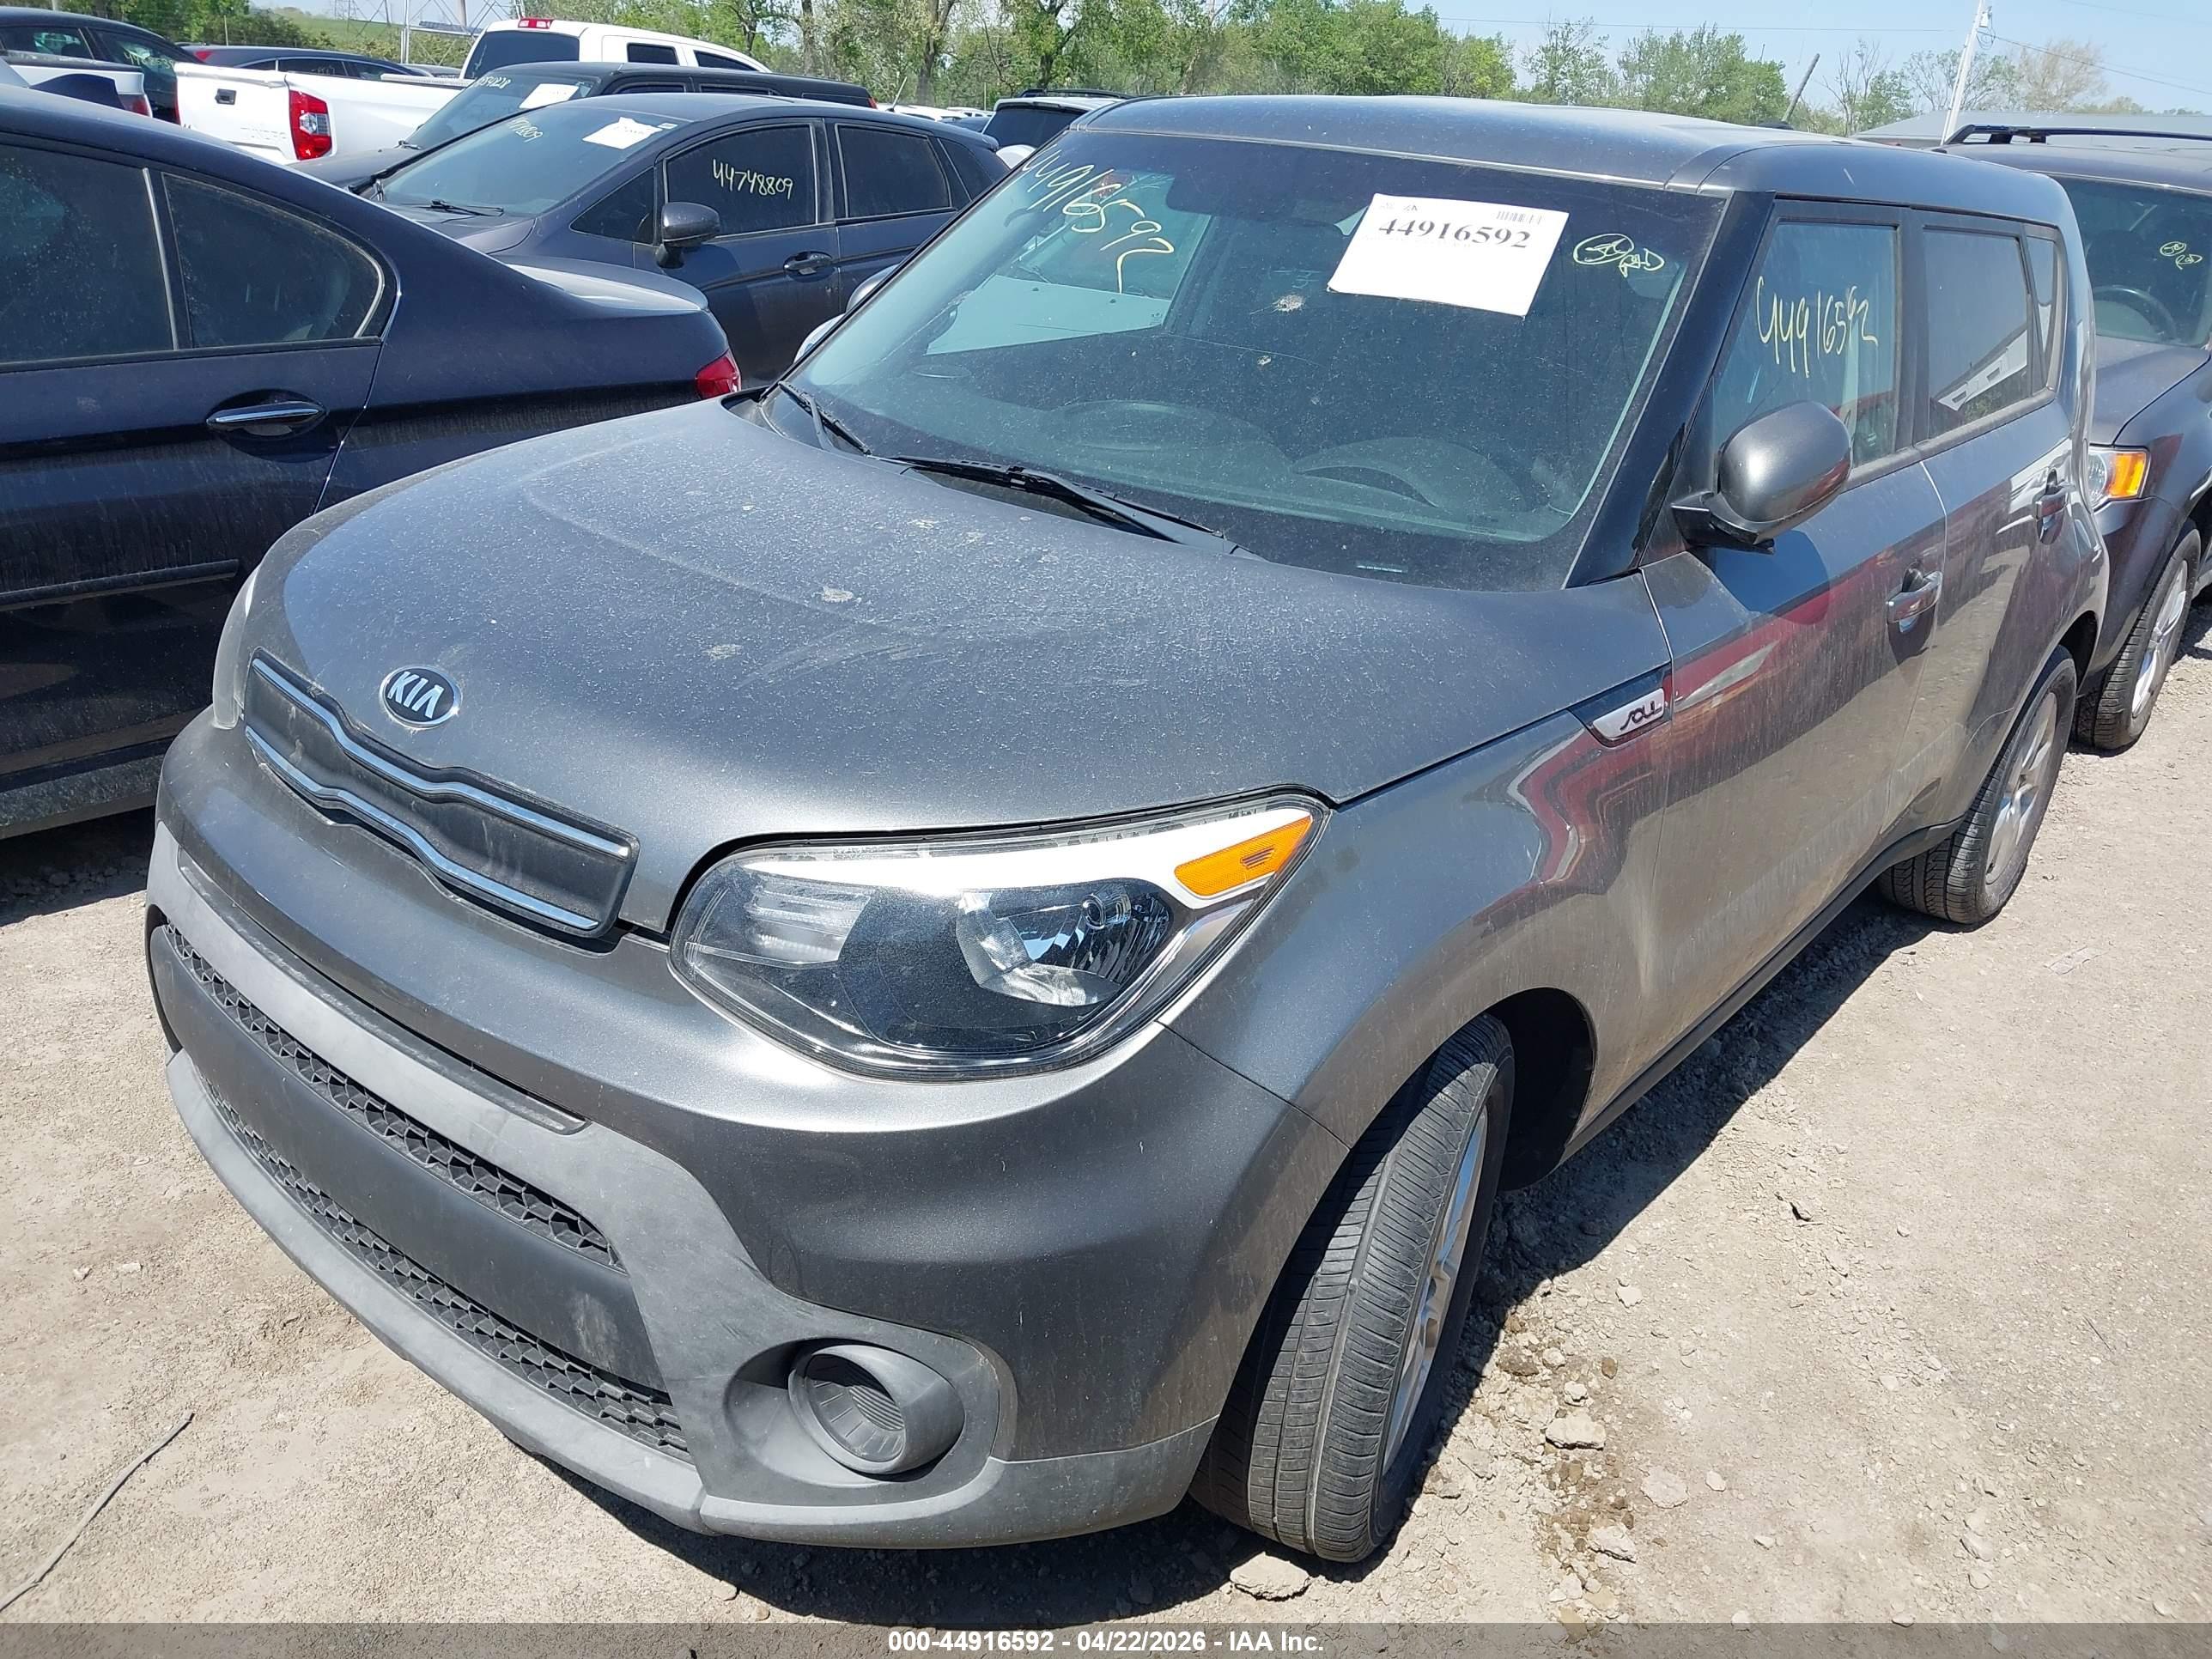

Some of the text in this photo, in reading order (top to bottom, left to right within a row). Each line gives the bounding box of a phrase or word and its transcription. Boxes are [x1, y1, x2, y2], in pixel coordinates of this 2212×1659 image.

[713, 158, 793, 200] 44748809
[1379, 218, 1531, 248] 44916592
[1756, 276, 1879, 379] 44916592
[387, 671, 445, 720] KIA
